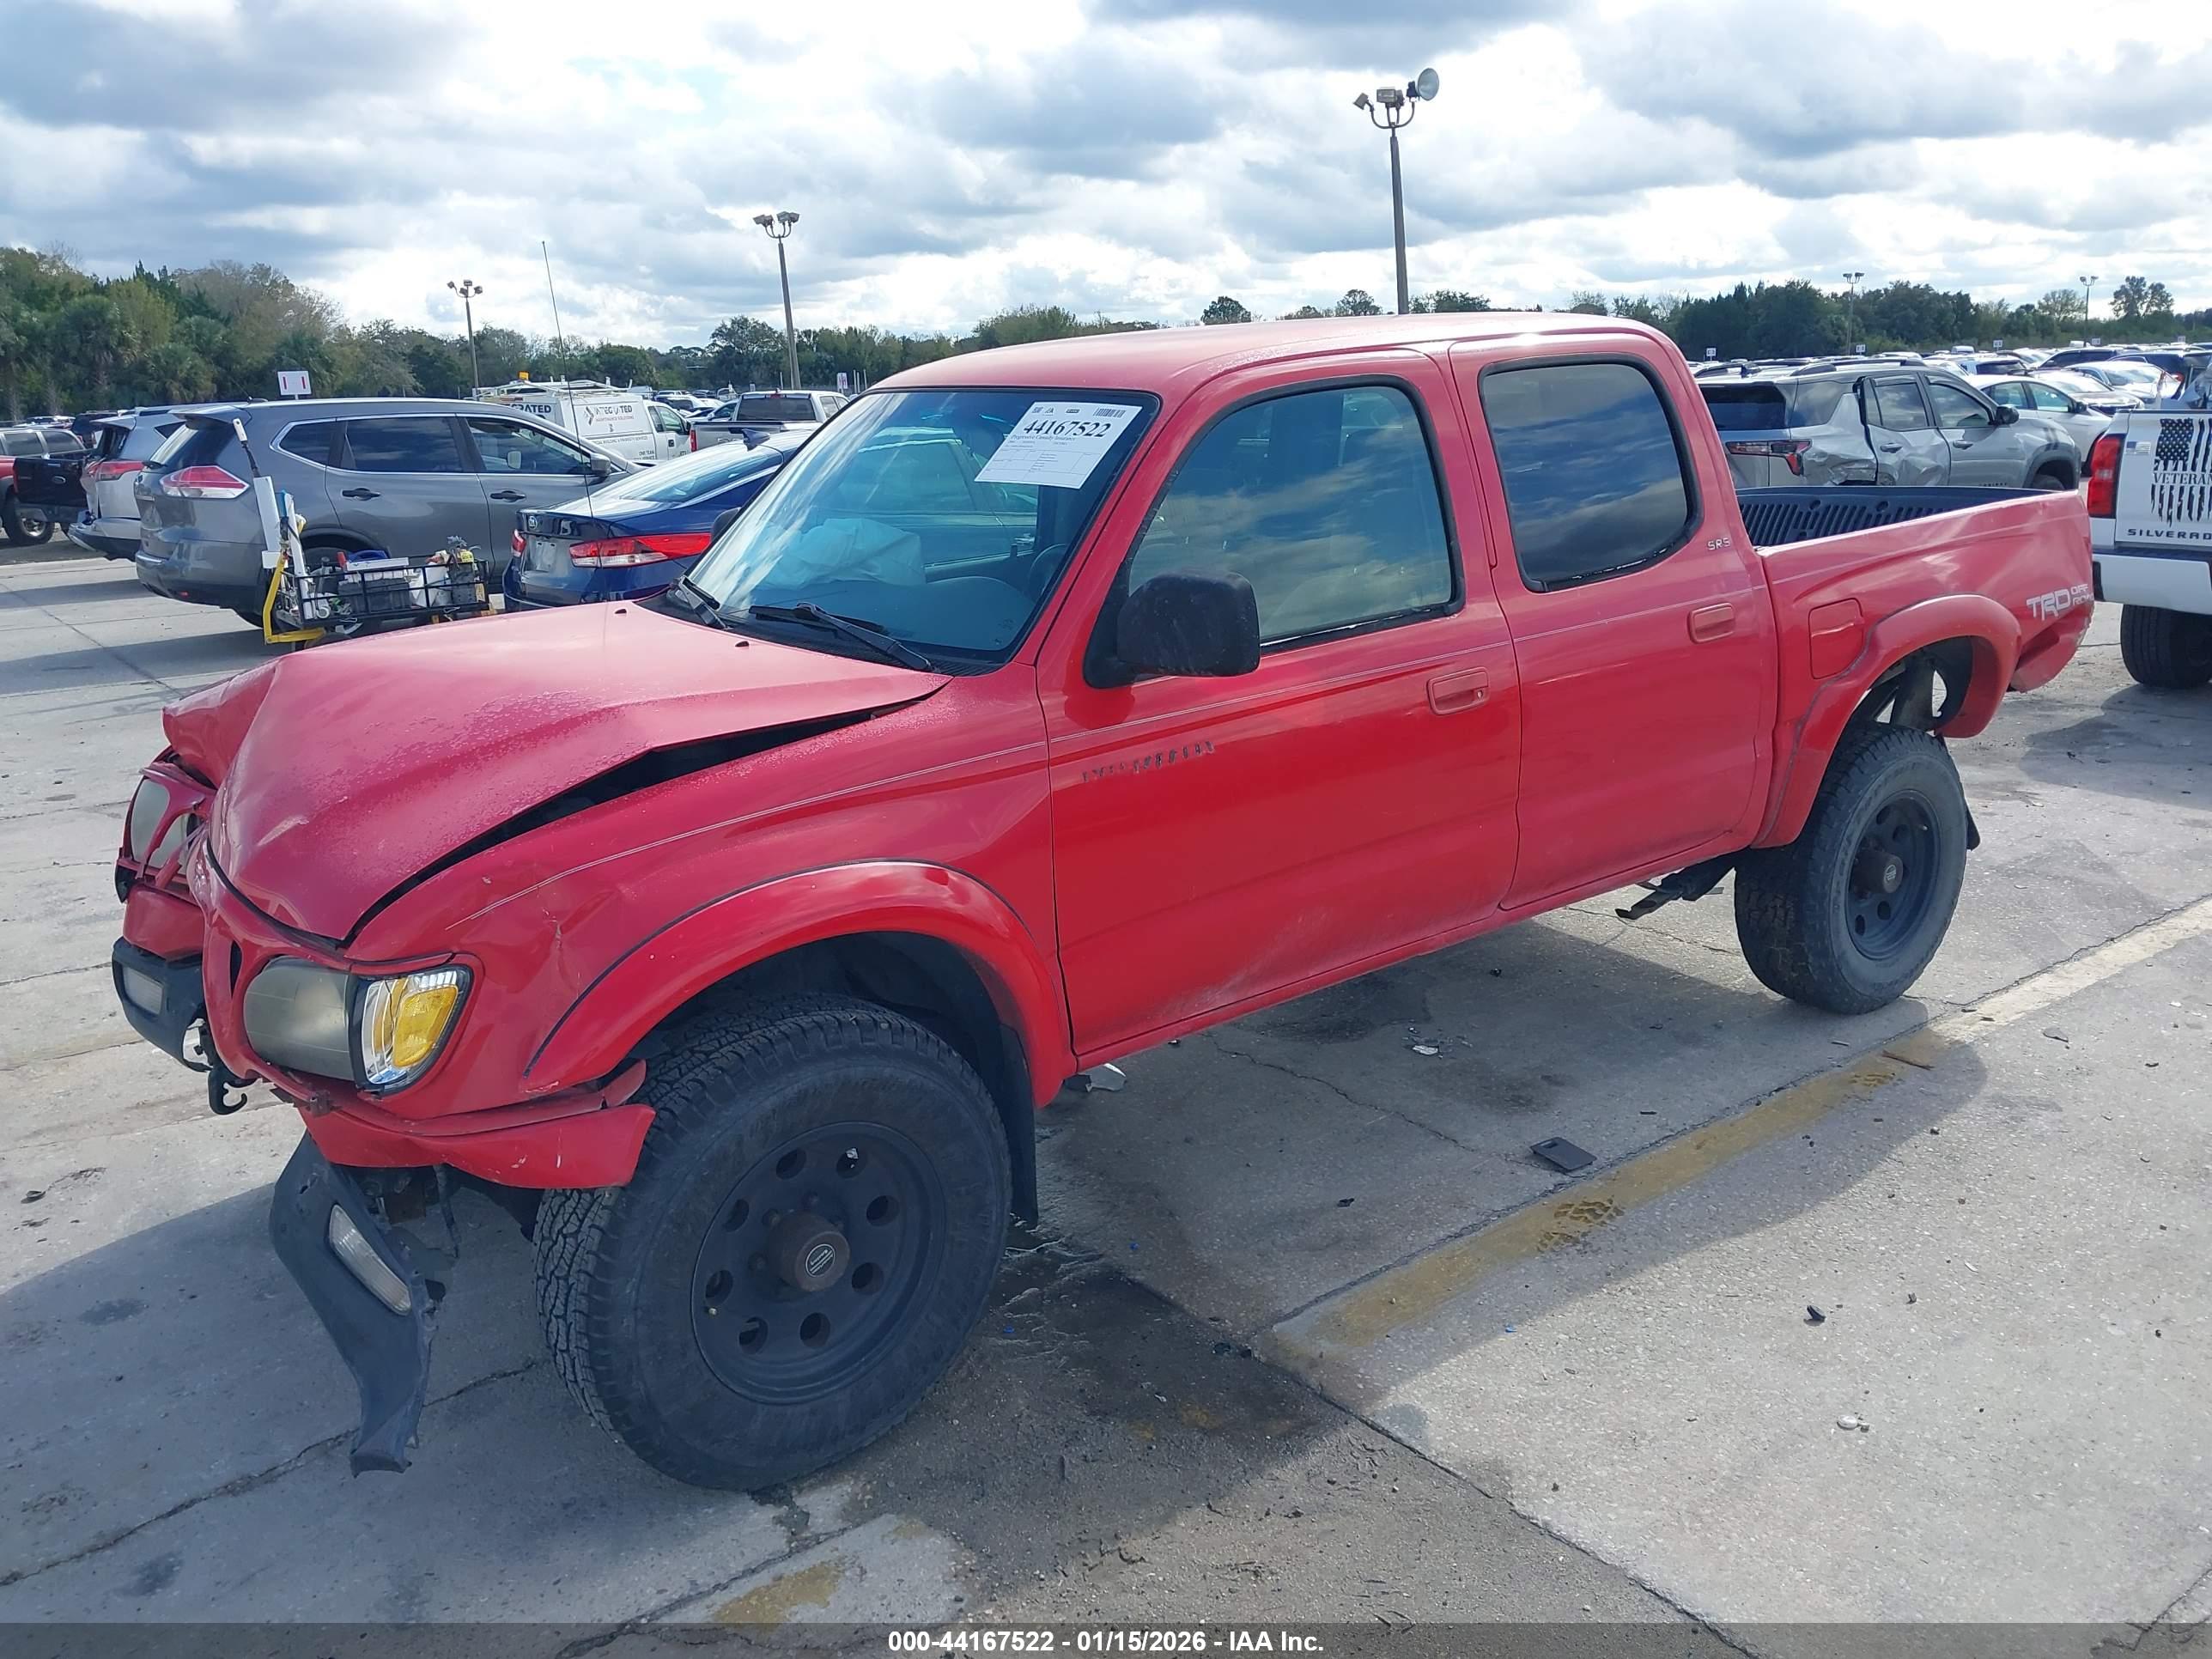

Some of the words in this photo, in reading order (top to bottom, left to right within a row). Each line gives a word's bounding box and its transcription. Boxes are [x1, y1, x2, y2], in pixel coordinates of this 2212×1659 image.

[1024, 419, 1111, 437] 44167522
[2070, 584, 2089, 595] OFF
[2026, 588, 2071, 621] TRD
